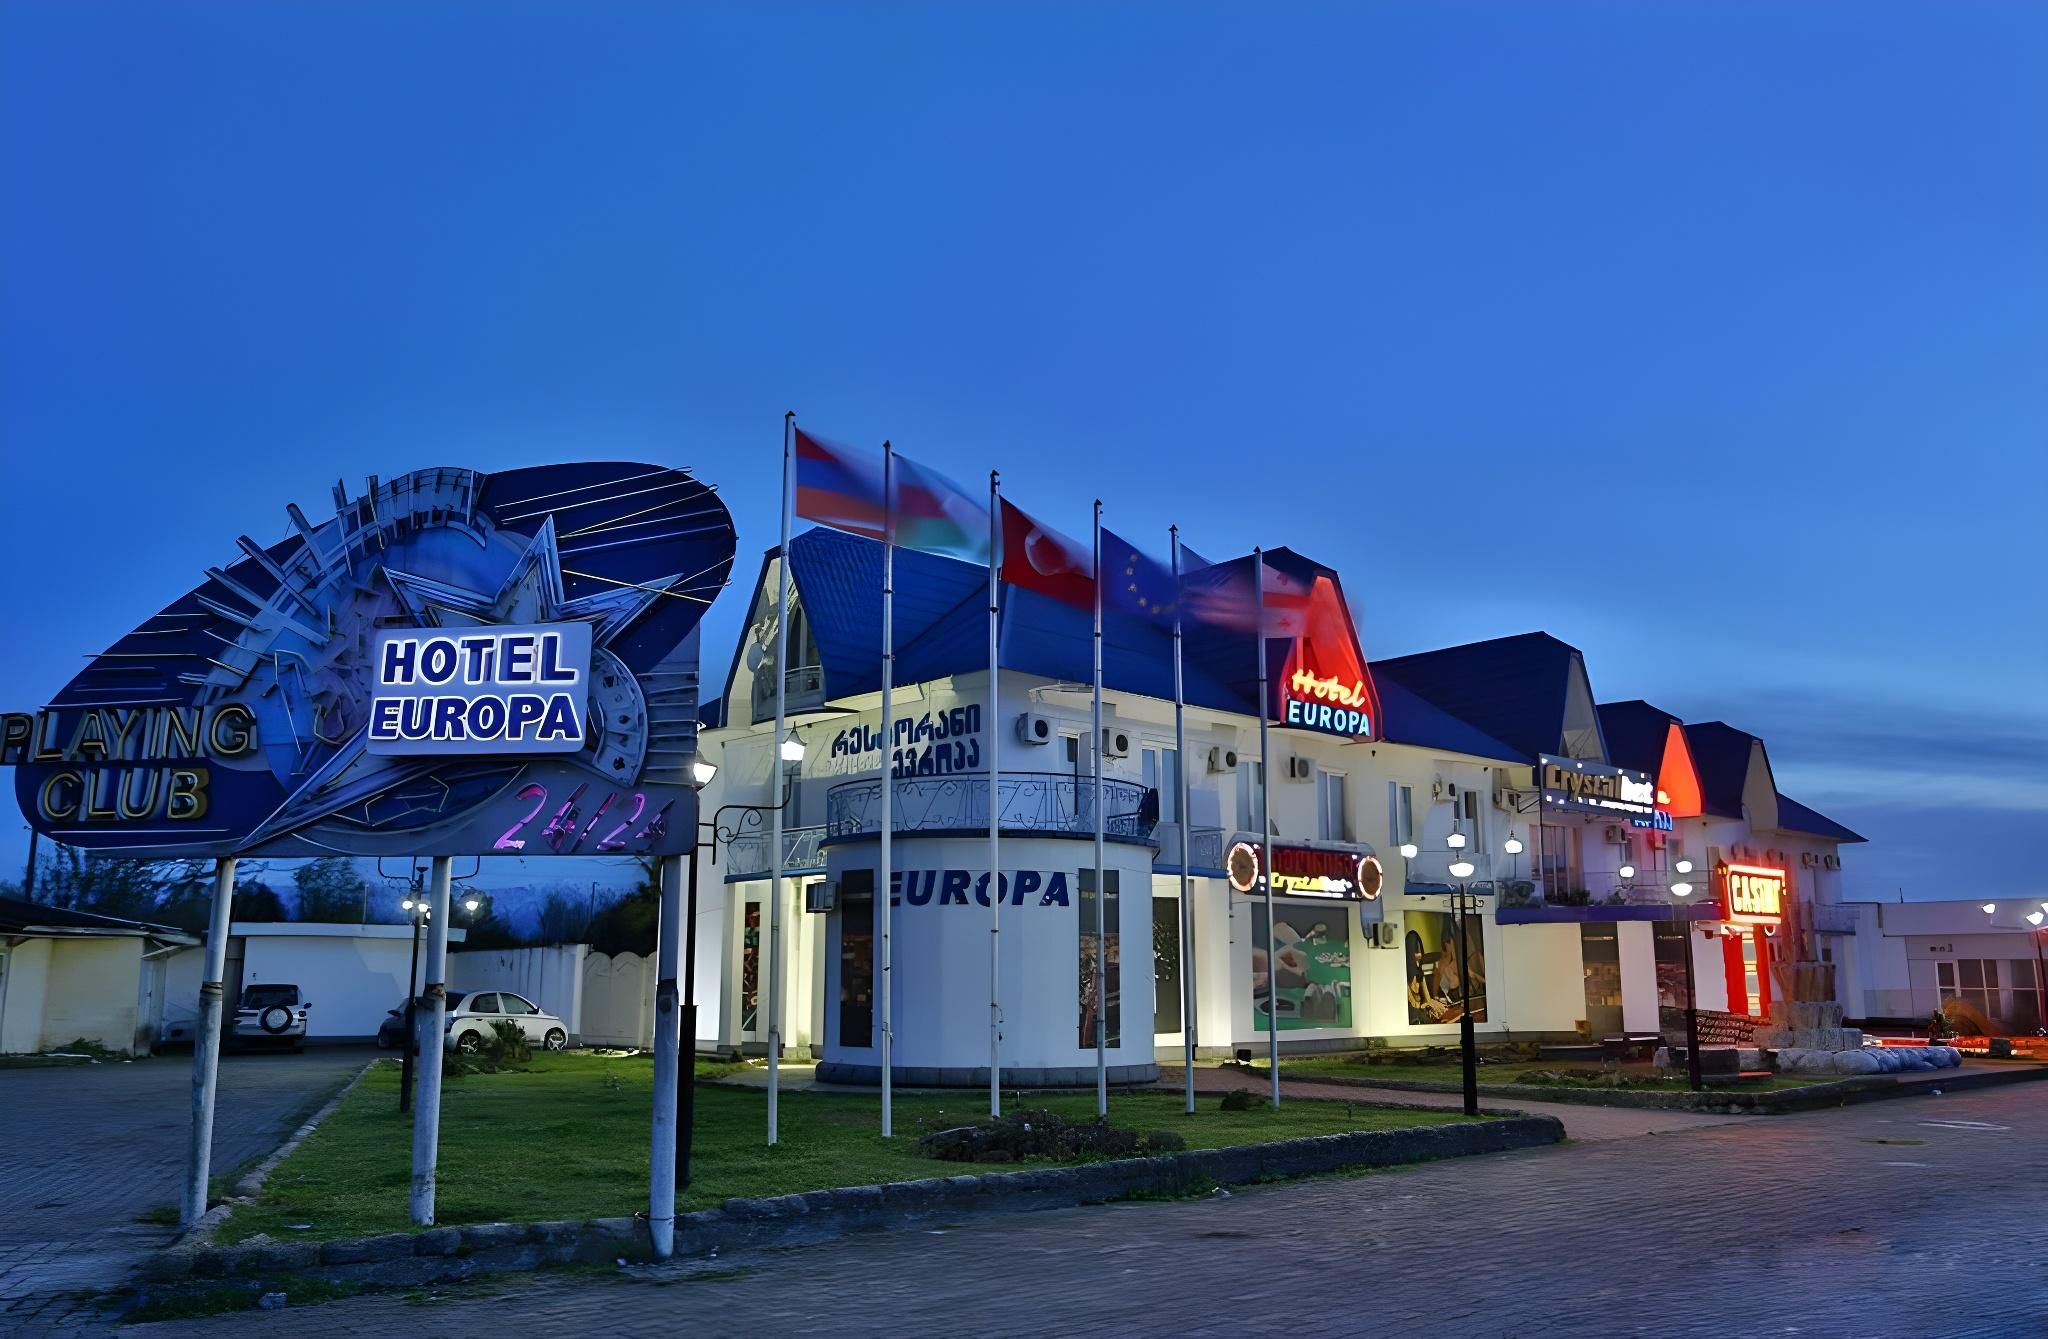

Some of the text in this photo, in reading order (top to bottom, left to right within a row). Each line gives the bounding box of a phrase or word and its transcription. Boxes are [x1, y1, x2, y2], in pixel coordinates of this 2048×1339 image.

[381, 632, 580, 686] HOTEL
[1291, 668, 1366, 708] Hotel
[0, 703, 258, 766] PLAYING
[368, 693, 584, 741] EUROPA
[1288, 699, 1371, 737] EUROPA
[38, 768, 209, 822] CLUB
[889, 869, 1070, 908] EUROPA
